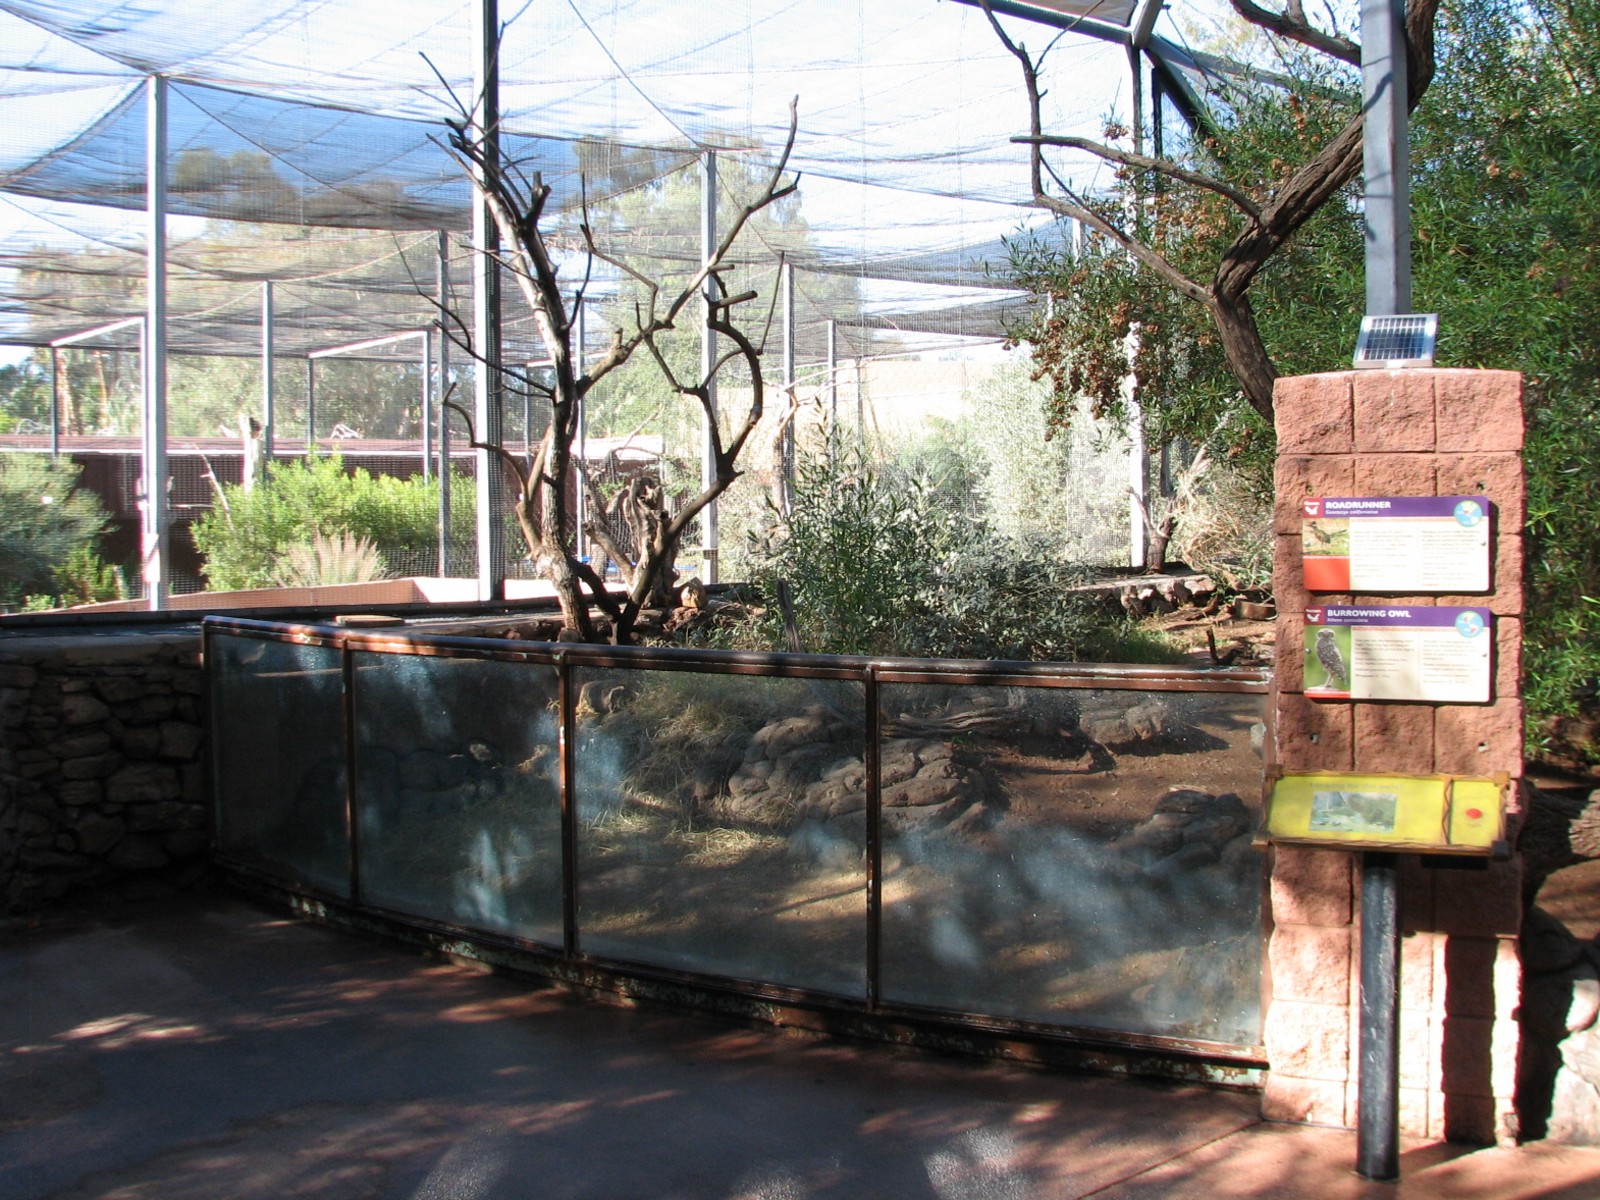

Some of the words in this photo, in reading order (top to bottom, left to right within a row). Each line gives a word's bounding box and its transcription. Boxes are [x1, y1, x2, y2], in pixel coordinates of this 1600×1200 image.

[1325, 501, 1391, 509] ROADRUNNER
[1327, 609, 1386, 617] BURROWING
[1388, 610, 1412, 618] OWL
